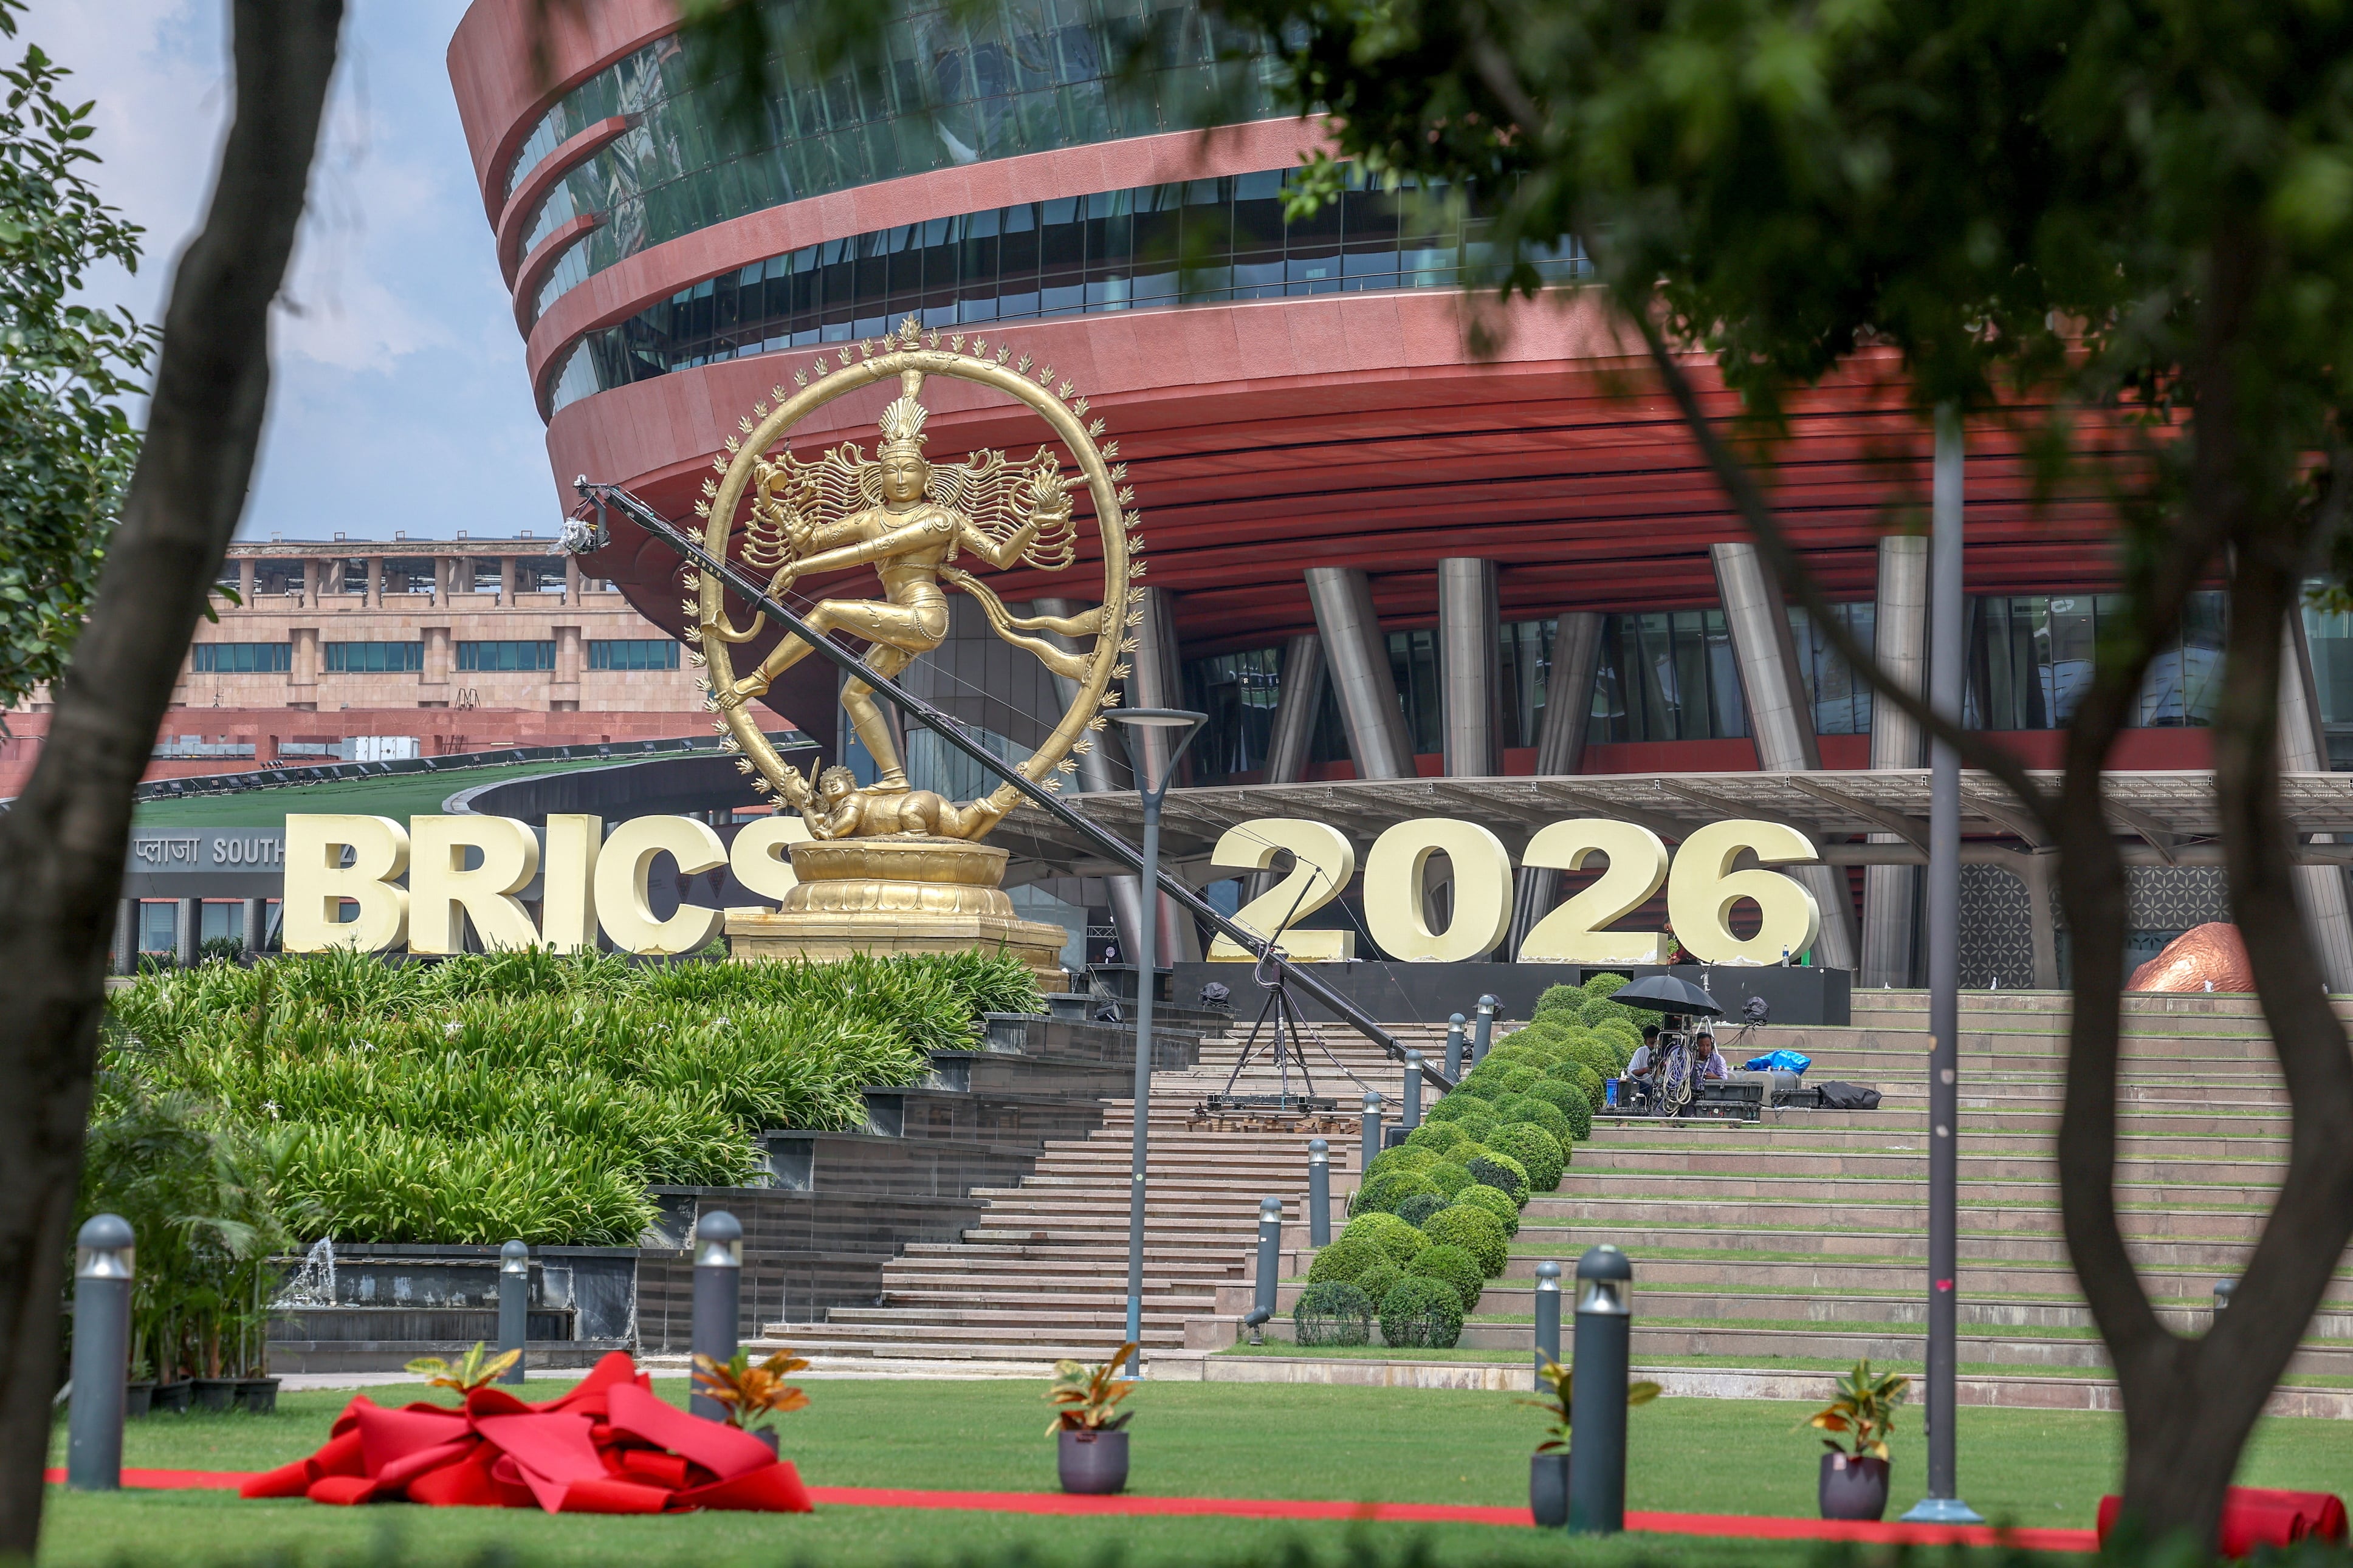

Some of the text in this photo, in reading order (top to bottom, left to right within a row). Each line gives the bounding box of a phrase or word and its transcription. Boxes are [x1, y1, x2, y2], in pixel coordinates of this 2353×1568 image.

[133, 838, 201, 863] प्लाजा
[213, 838, 286, 863] SOUTH
[1206, 818, 1820, 966] 2026
